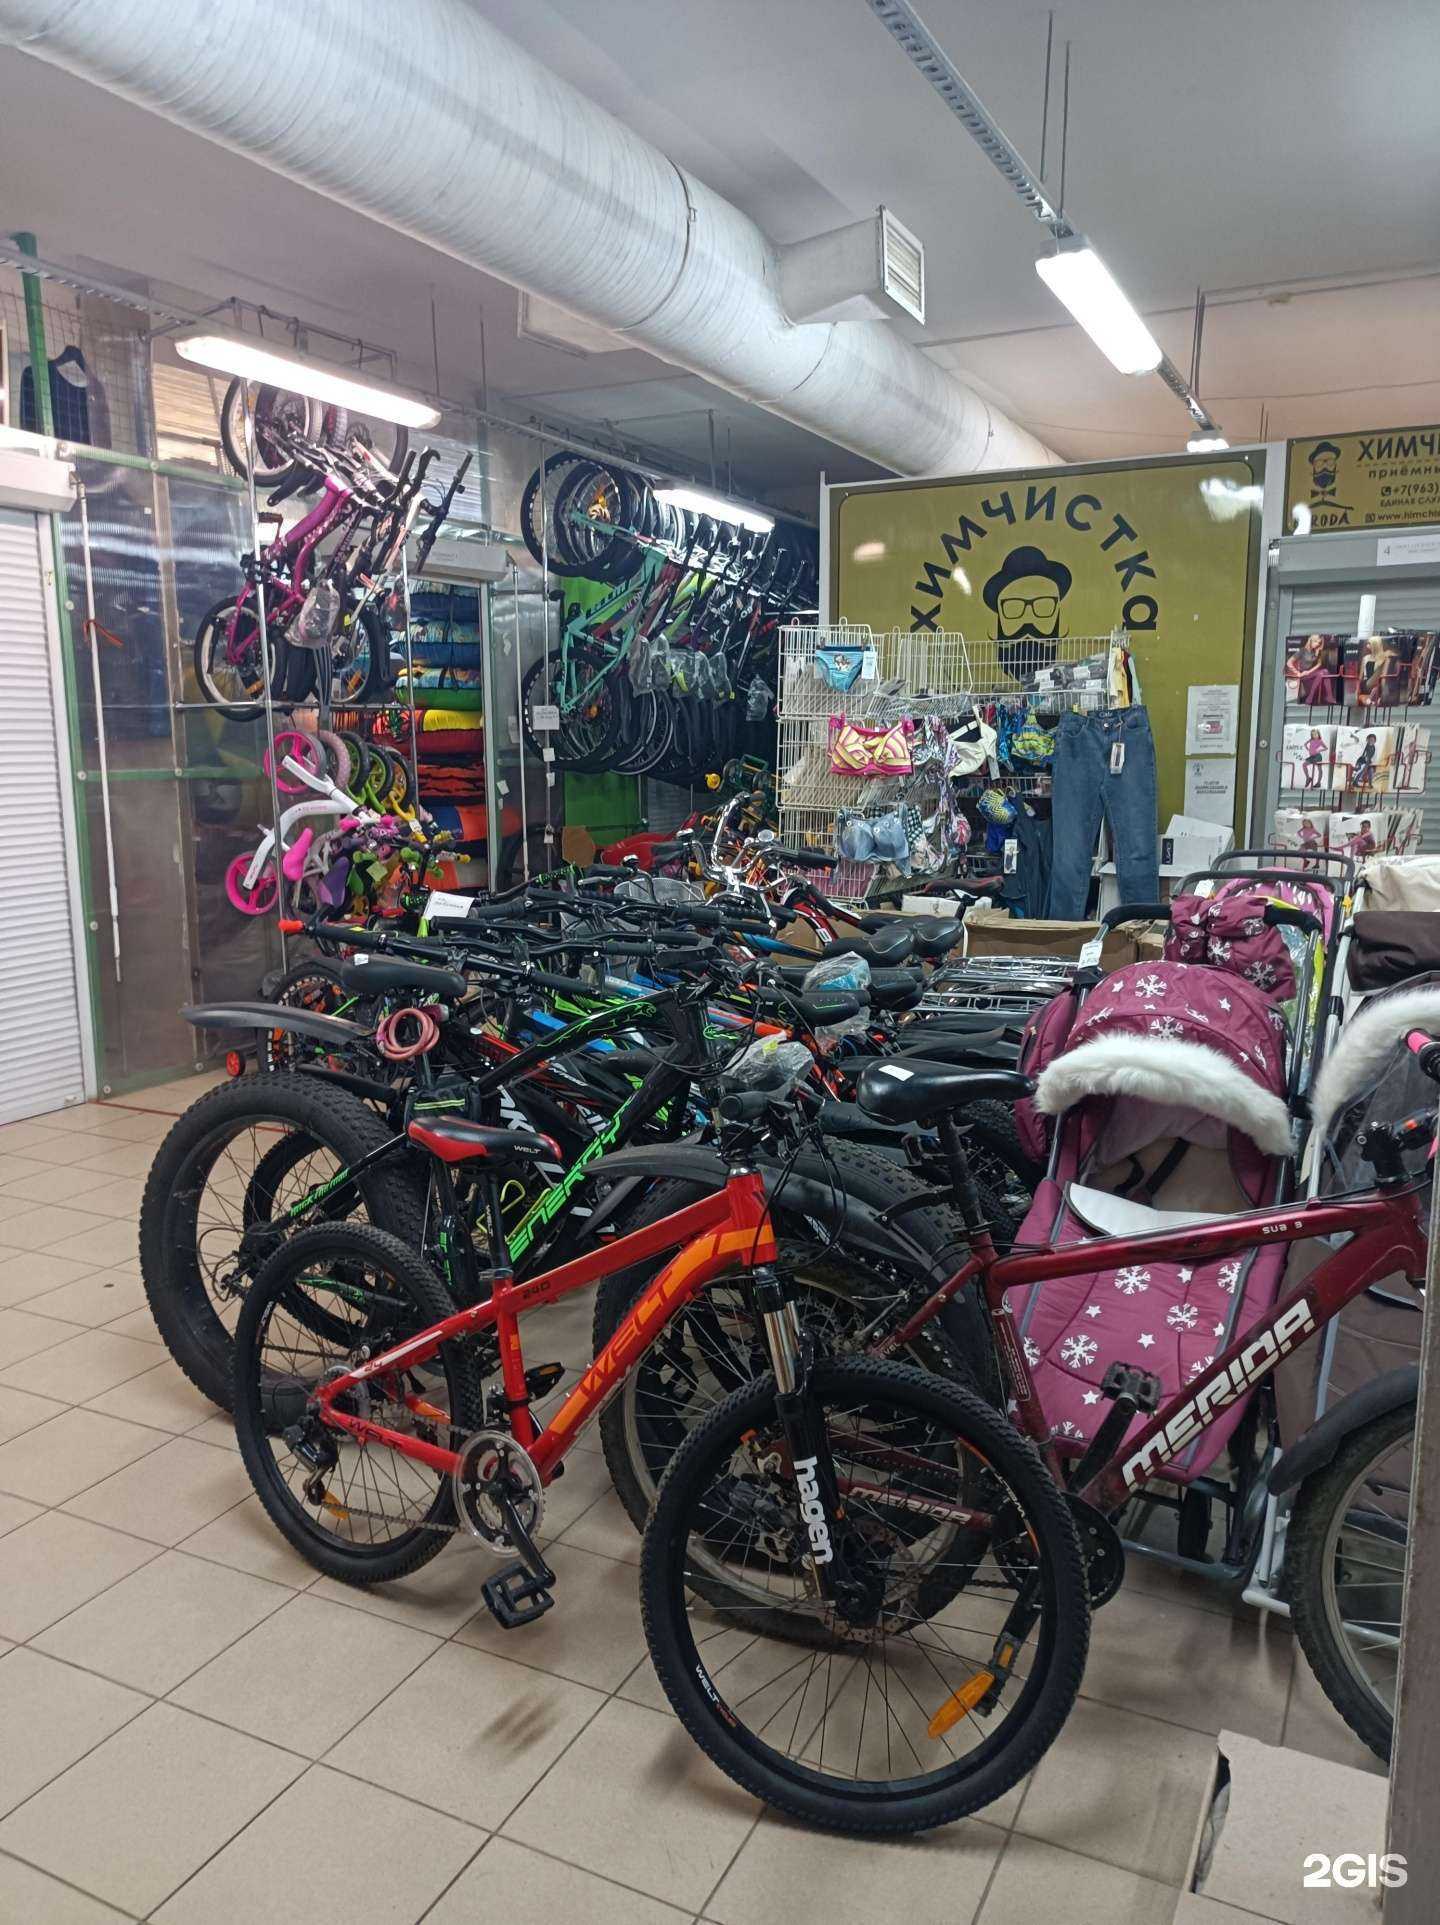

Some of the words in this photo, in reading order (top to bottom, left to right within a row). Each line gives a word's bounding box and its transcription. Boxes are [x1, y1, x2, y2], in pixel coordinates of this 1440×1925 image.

[1357, 433, 1440, 461] ХИМЧ
[513, 1144, 541, 1154] WELT
[1122, 1298, 1315, 1493] MERIDA
[794, 1456, 834, 1565] hagen
[695, 1664, 720, 1703] WELT
